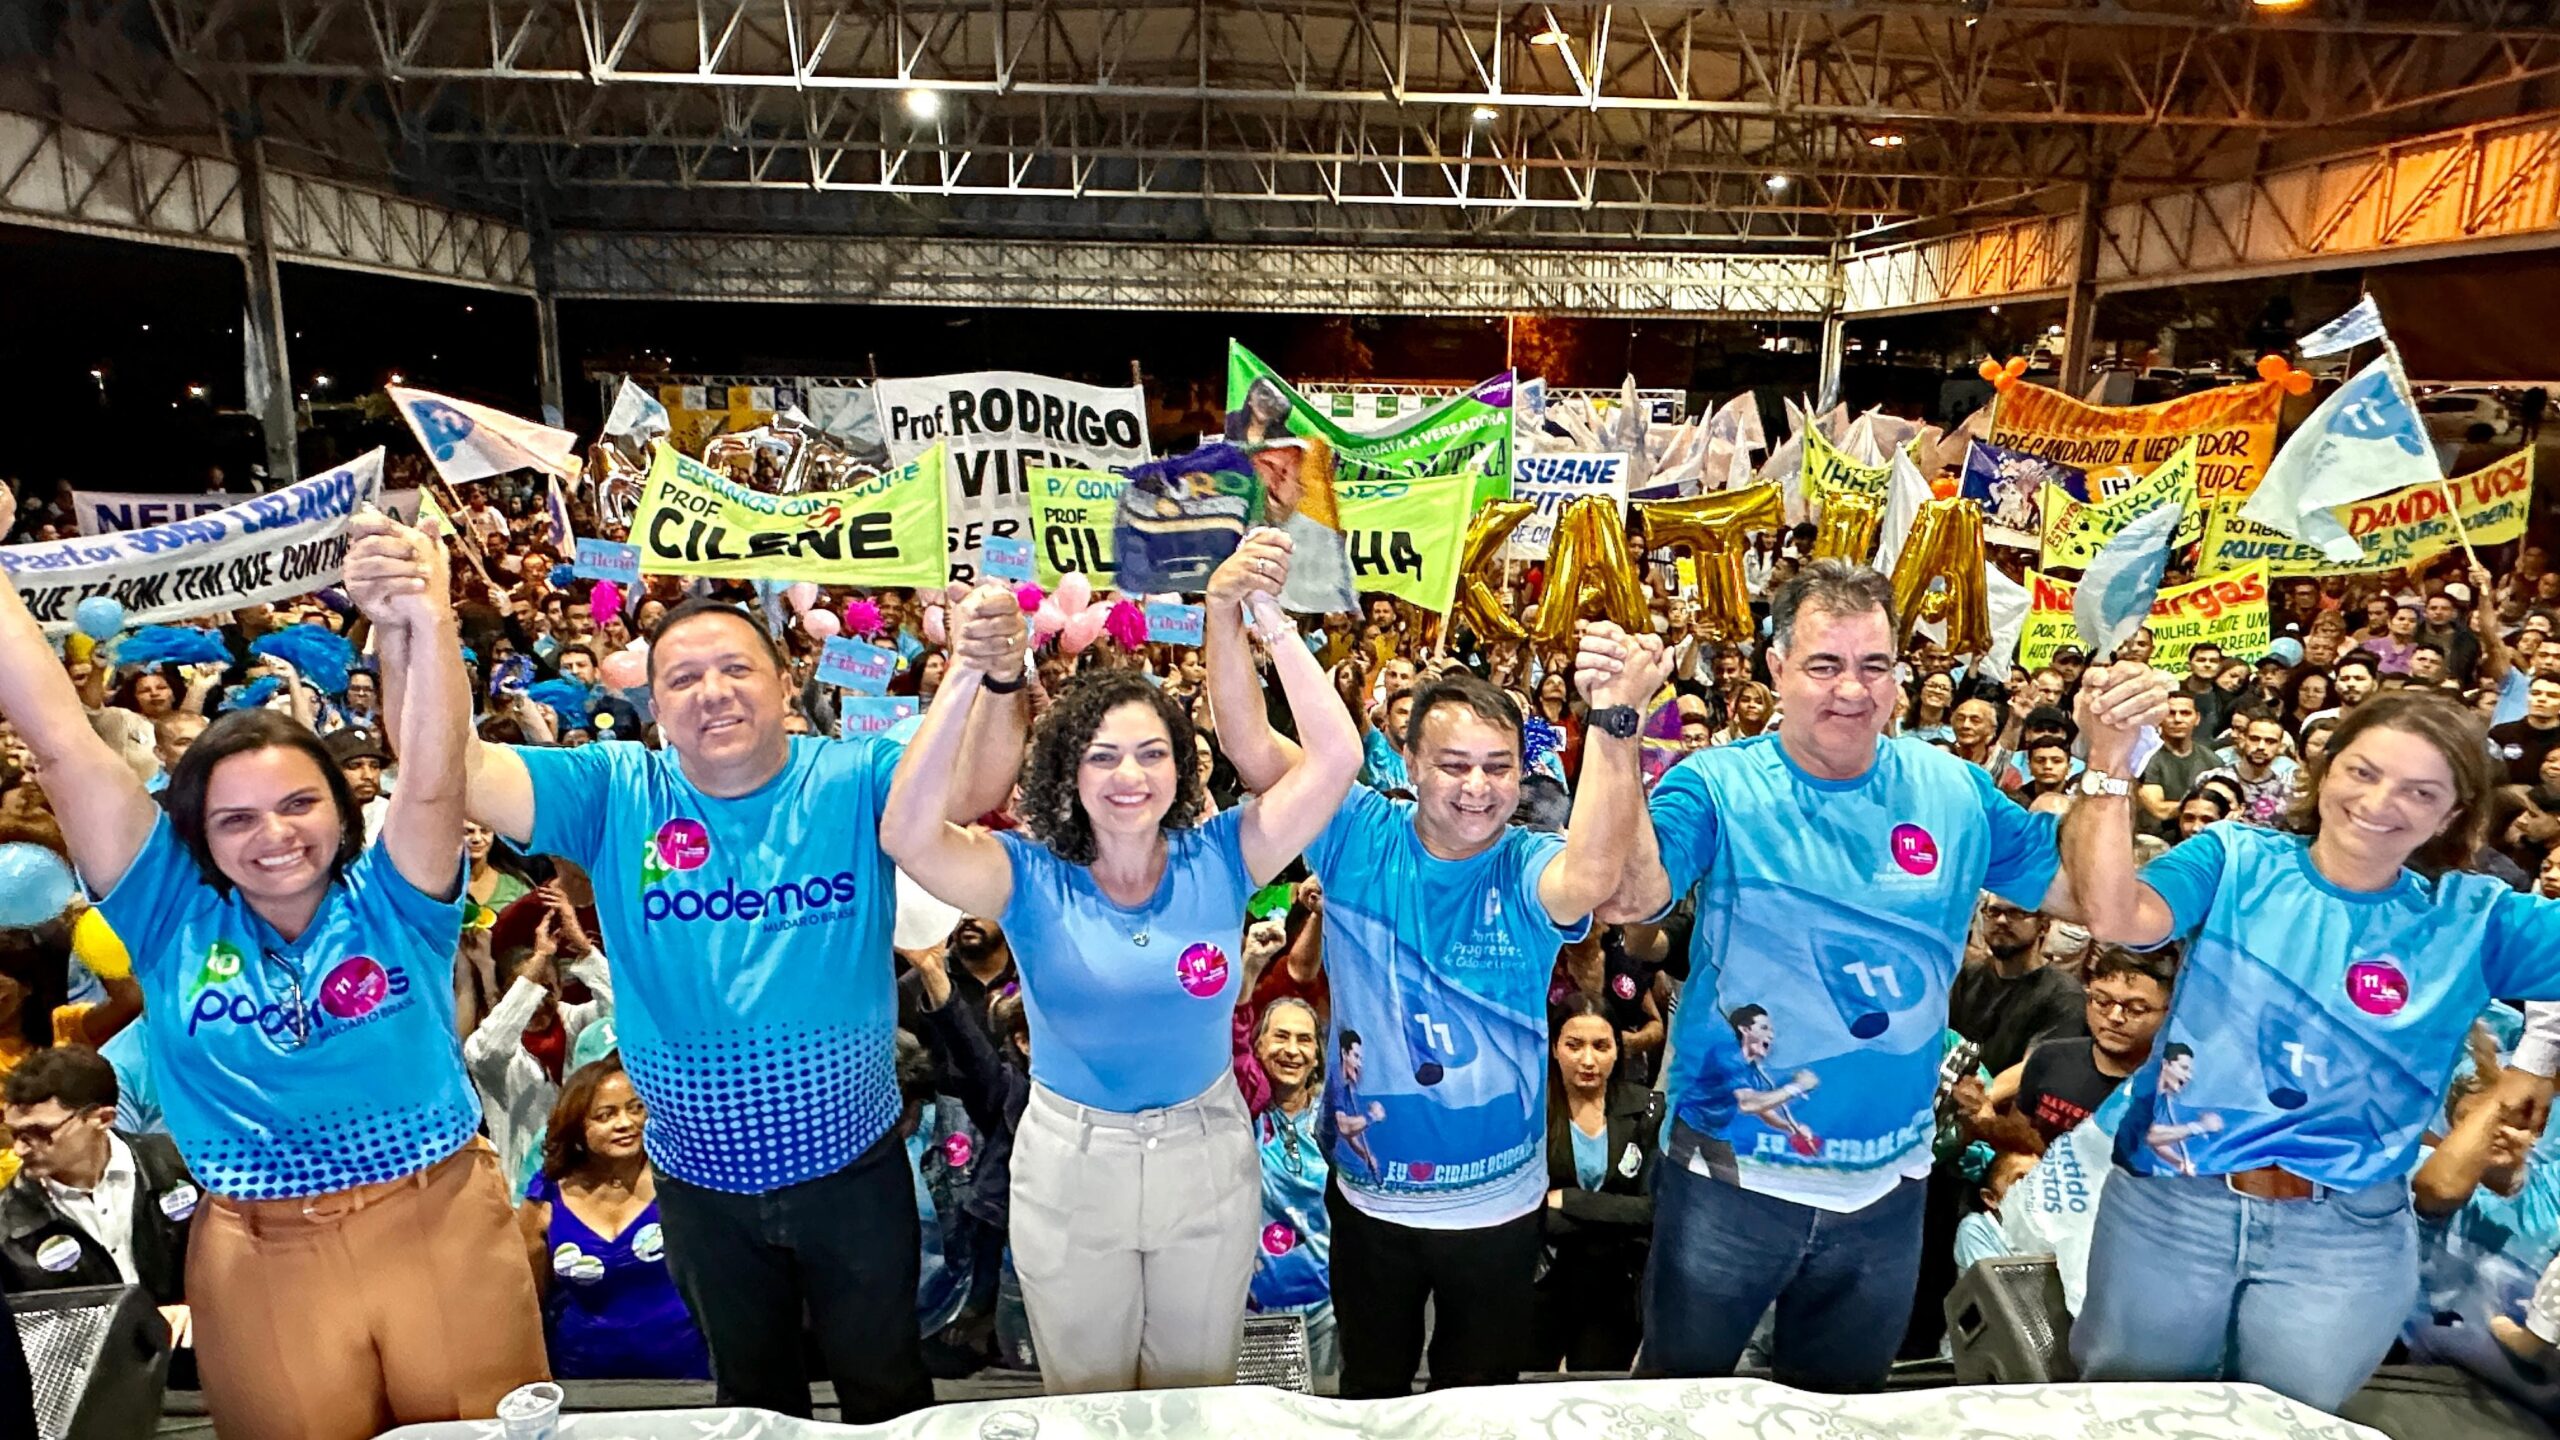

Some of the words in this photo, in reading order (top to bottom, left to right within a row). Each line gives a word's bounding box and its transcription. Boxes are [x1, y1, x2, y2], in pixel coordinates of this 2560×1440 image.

[891, 405, 948, 440] Prof.
[948, 388, 1142, 449] RODRIGO
[1419, 410, 1507, 445] VEREADORA
[2121, 438, 2140, 464] A
[1515, 457, 1620, 485] SUANE
[2349, 482, 2462, 536] DANDO
[2472, 457, 2528, 503] VOZ
[649, 506, 900, 561] CILENE
[0, 545, 123, 573] Pastor
[172, 561, 226, 602] TEM
[228, 551, 273, 597] QUE
[2031, 575, 2077, 614] Na
[2031, 623, 2056, 639] POR
[2153, 622, 2201, 640] MULHER
[674, 831, 688, 845] 11
[1902, 837, 1916, 851] 11
[643, 871, 857, 936] podemos
[1191, 957, 1207, 973] 11
[335, 976, 352, 995] 11
[1842, 961, 1902, 999] 11
[2361, 974, 2379, 989] 11
[1414, 1013, 1455, 1056] 11
[1384, 1160, 1409, 1182] EU
[1434, 1158, 1487, 1184] CIDADE
